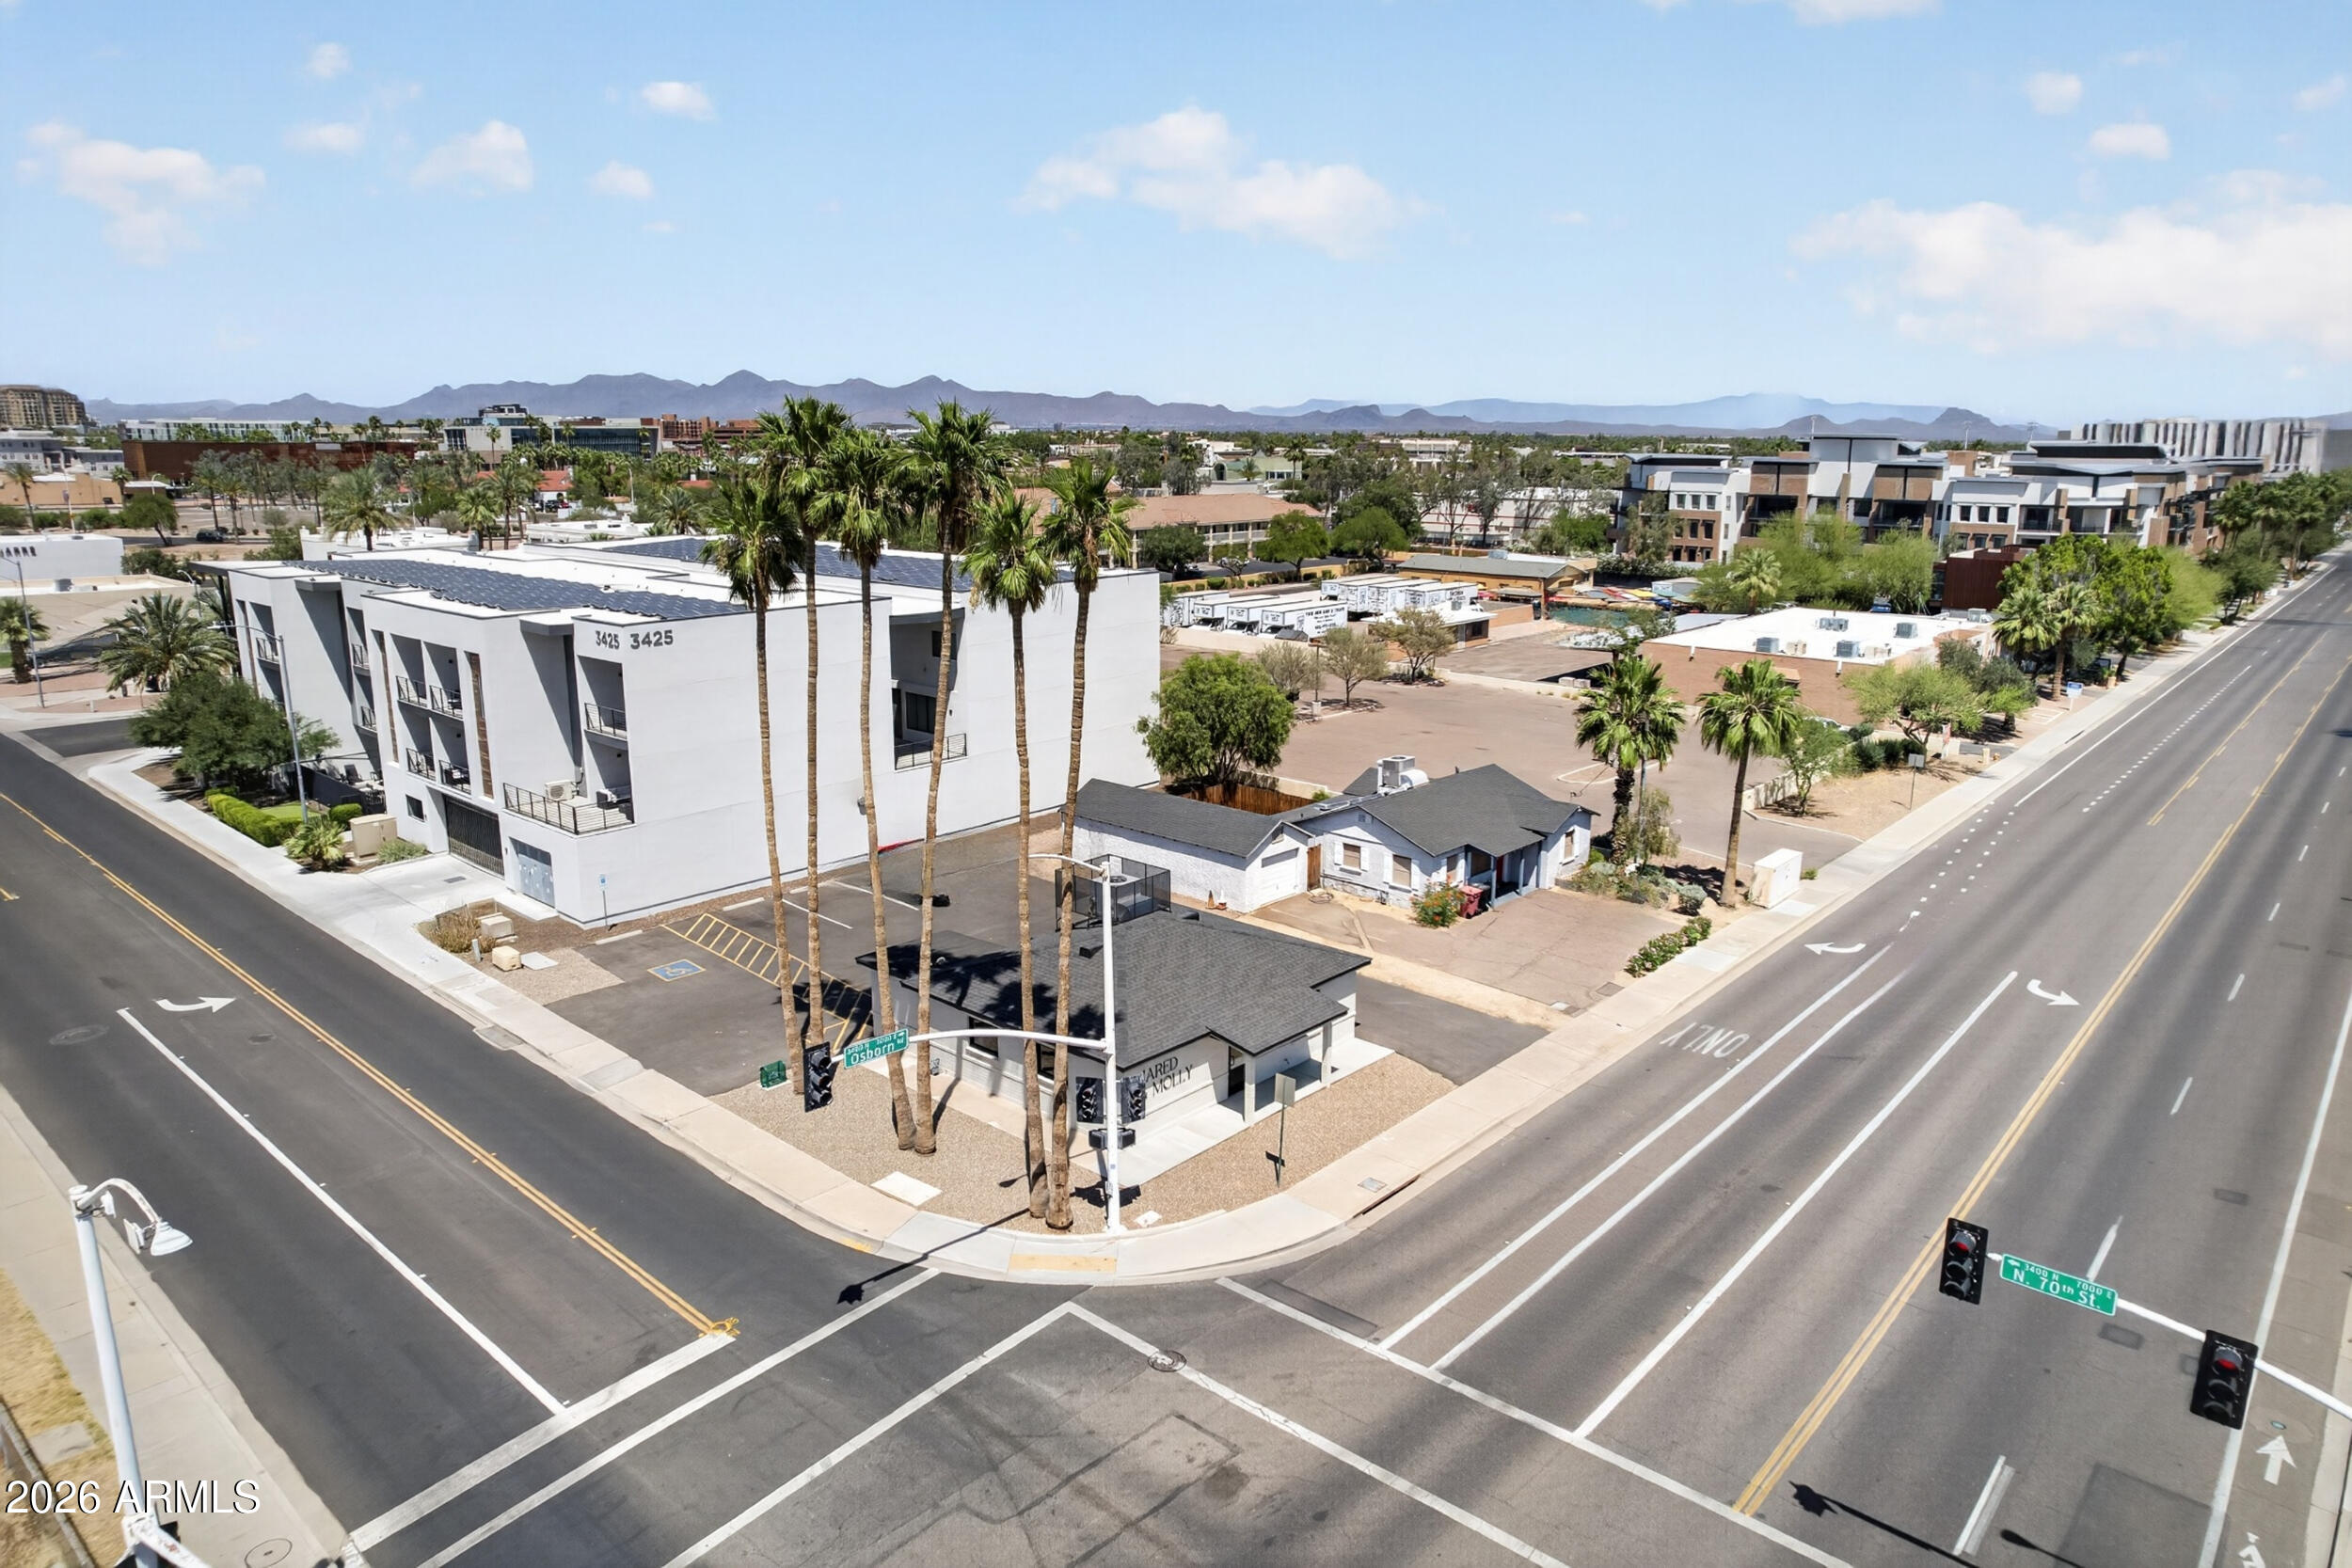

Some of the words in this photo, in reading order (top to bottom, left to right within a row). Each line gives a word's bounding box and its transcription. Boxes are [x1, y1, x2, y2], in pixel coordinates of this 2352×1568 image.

[595, 630, 620, 650] 3425
[629, 629, 674, 650] 3425
[850, 1042, 895, 1065] Osborn
[1659, 1022, 1750, 1058] ONLY
[1152, 1064, 1193, 1098] MOLLY
[2012, 1268, 2030, 1285] N.
[2039, 1276, 2074, 1295] 70th
[2077, 1291, 2101, 1309] St.
[2024, 1263, 2048, 1278] 3400
[2052, 1273, 2059, 1282] N
[2076, 1280, 2103, 1295] 7000
[2106, 1291, 2113, 1300] E
